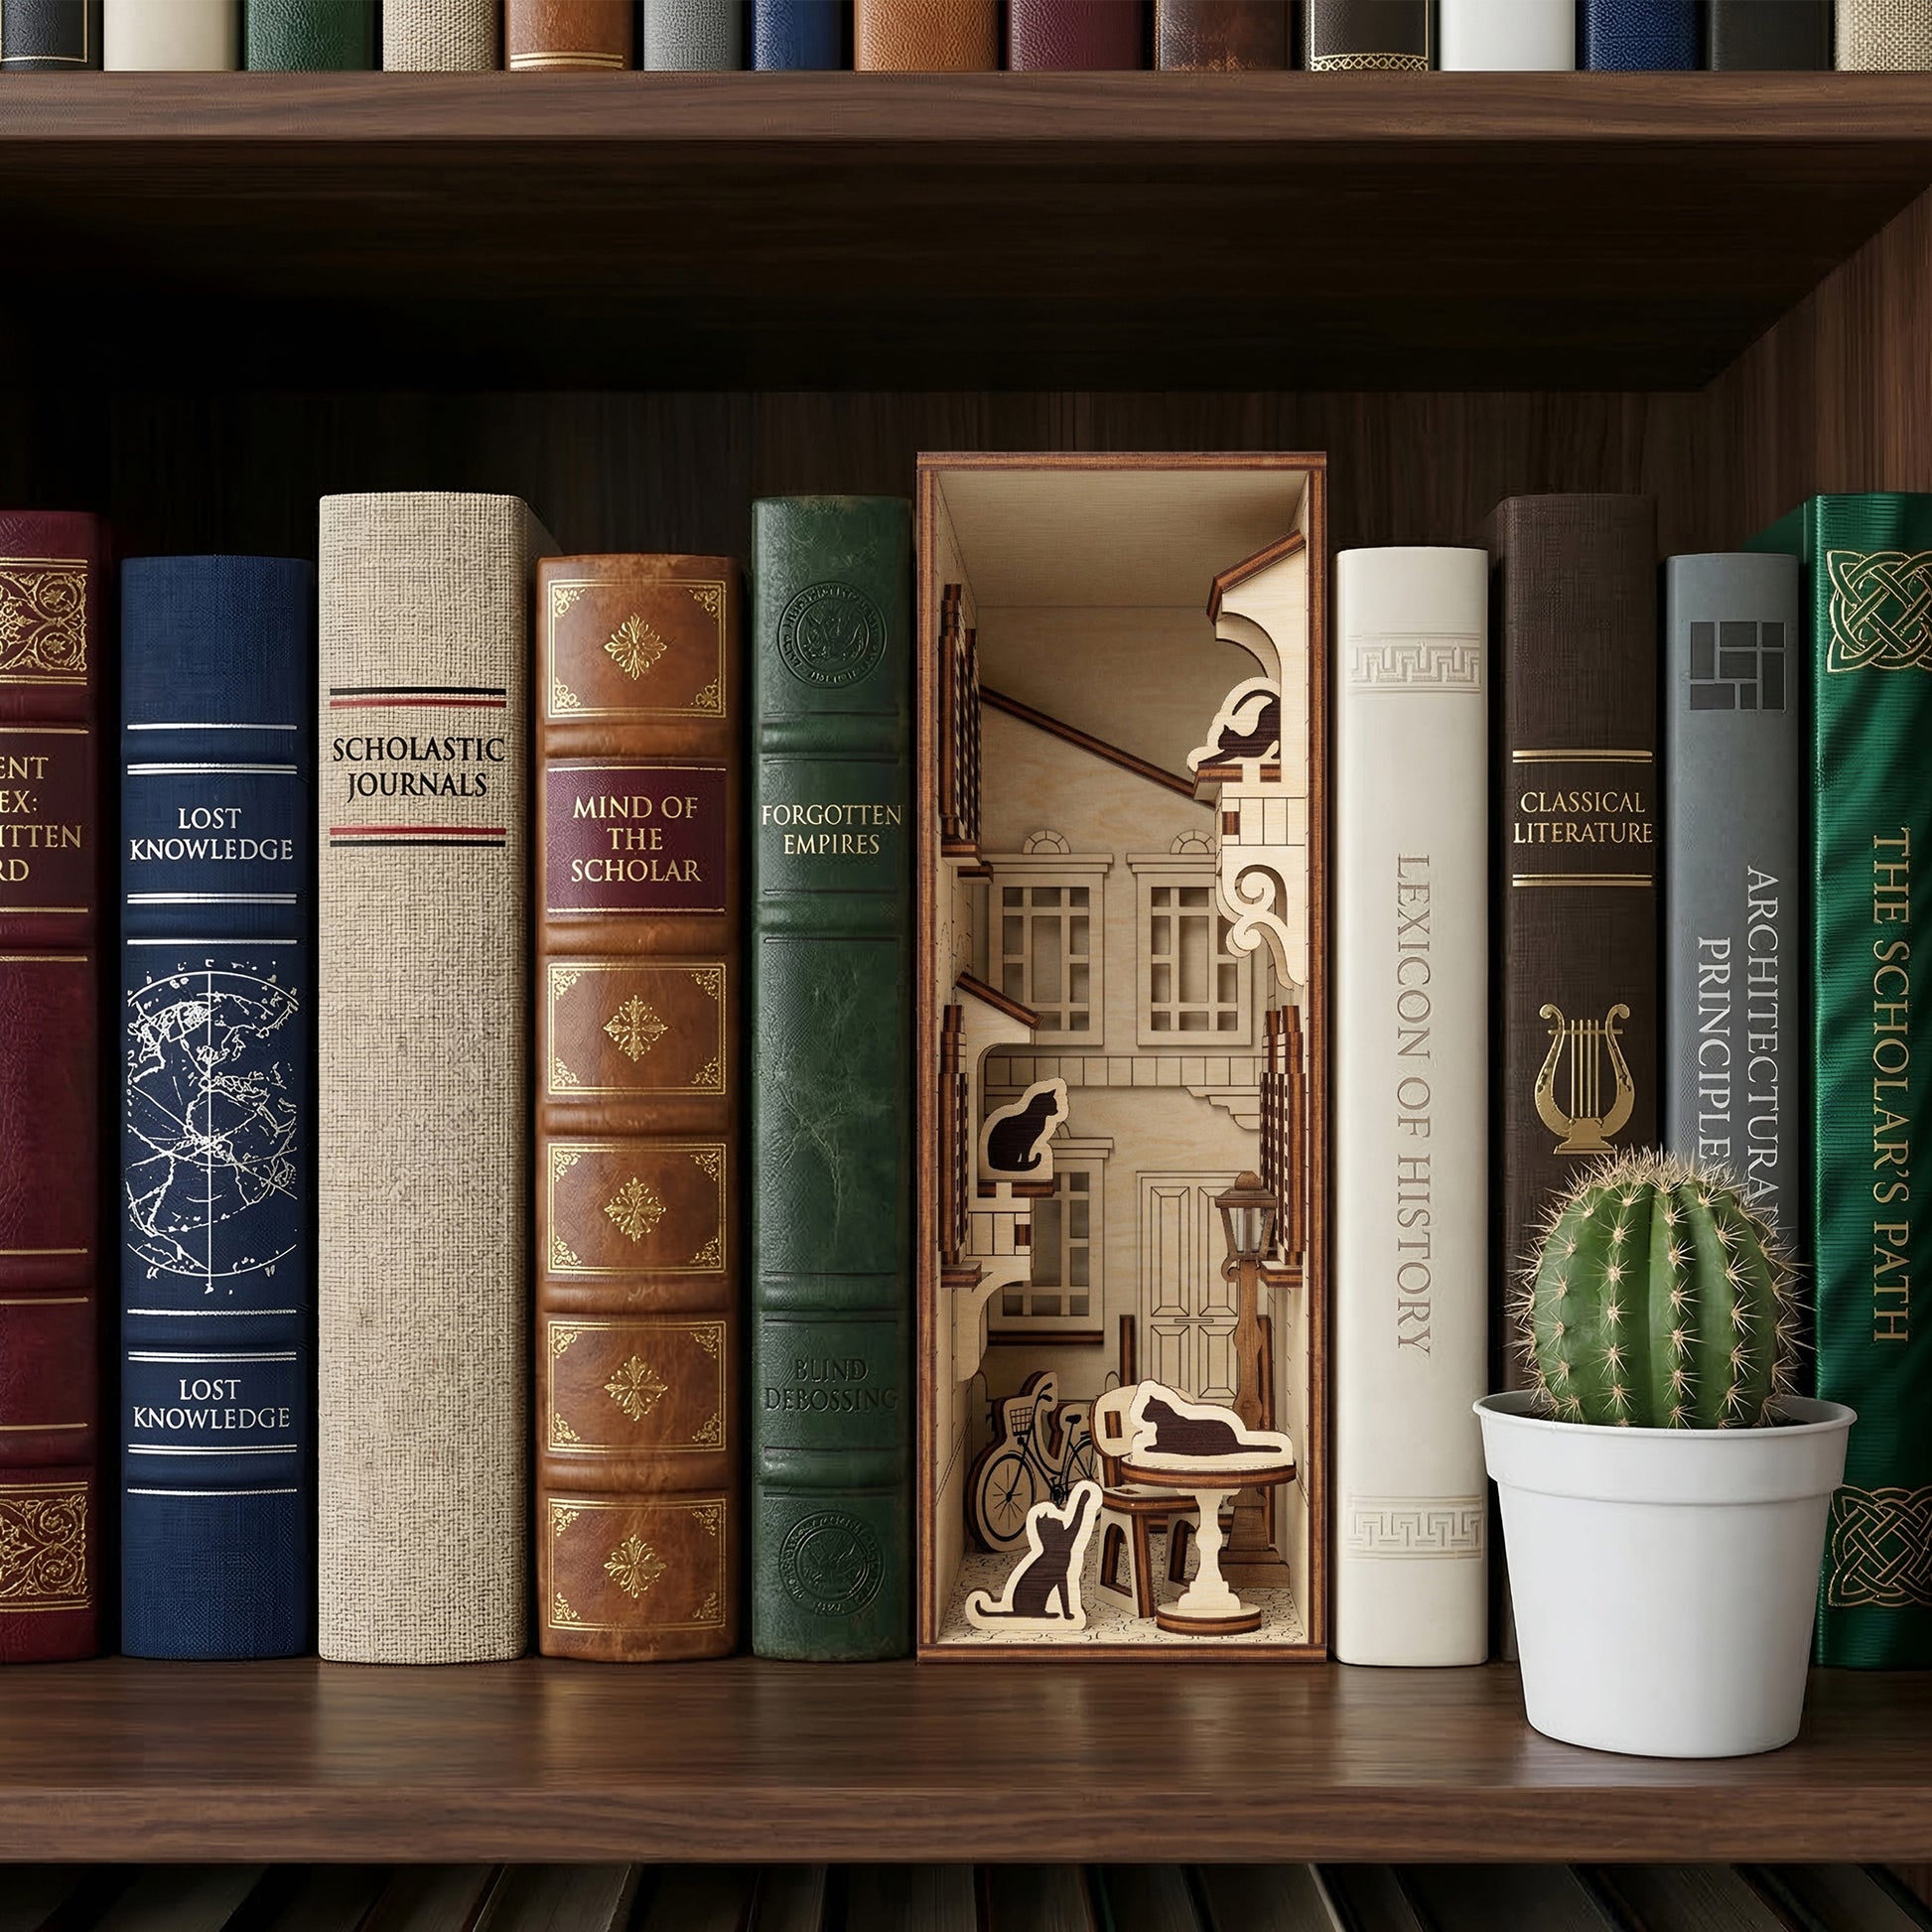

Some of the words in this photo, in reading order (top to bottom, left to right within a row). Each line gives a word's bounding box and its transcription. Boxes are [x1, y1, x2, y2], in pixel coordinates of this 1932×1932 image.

[333, 737, 506, 762] SCHOLASTIC
[347, 771, 488, 803] JOURNALS
[573, 795, 653, 819] MIND
[660, 795, 699, 819] OF
[1520, 791, 1645, 813] CLASSICAL
[178, 807, 242, 829] LOST
[761, 804, 901, 826] FORGOTTEN
[606, 827, 663, 851] THE
[783, 834, 880, 855] EMPIRES
[1513, 822, 1653, 843] LITERATURE
[129, 838, 294, 861] KNOWLEDGE
[571, 859, 702, 883] SCHOLAR
[1873, 826, 1910, 924] THE
[1396, 854, 1431, 1059] LEXICON
[1396, 1076, 1432, 1139] OF
[1396, 1154, 1432, 1353] HISTORY
[1873, 1220, 1910, 1342] PATH
[795, 1358, 869, 1383] BLIND
[179, 1379, 241, 1401] LOST
[763, 1387, 898, 1412] DEBOSSING
[133, 1407, 291, 1430] KNOWLEDGE
